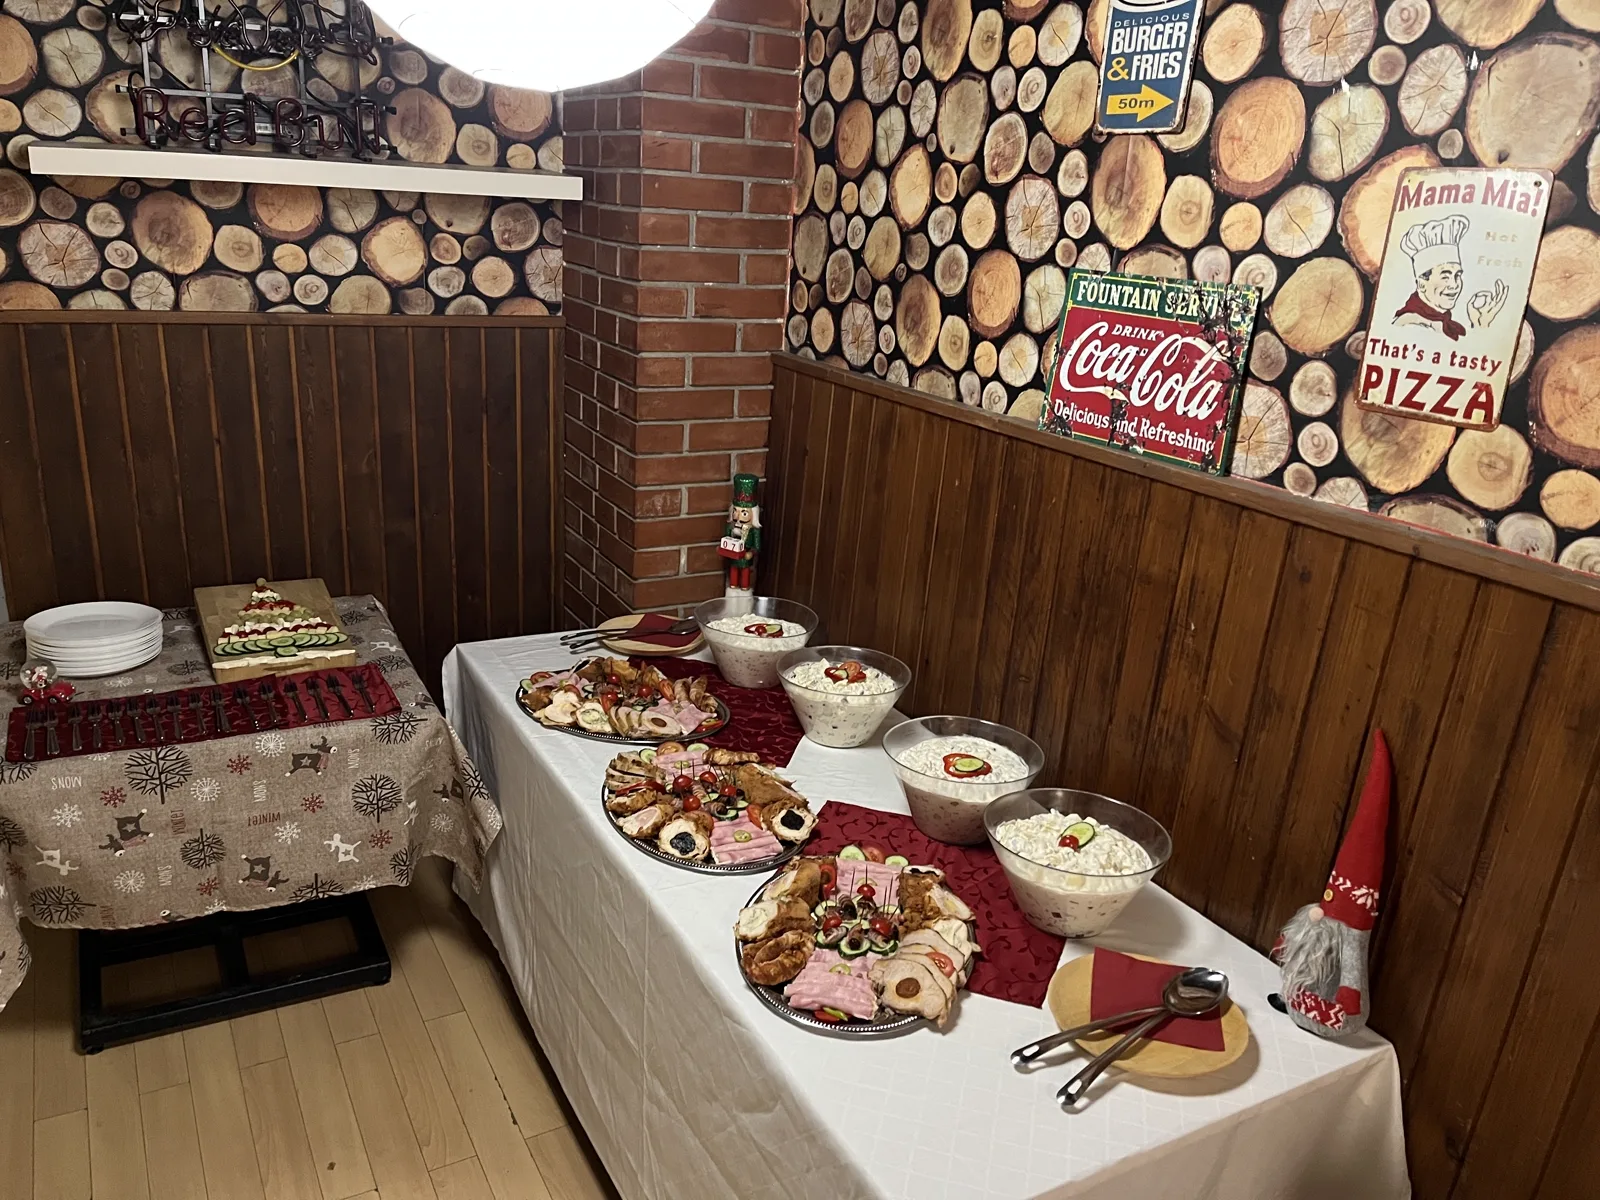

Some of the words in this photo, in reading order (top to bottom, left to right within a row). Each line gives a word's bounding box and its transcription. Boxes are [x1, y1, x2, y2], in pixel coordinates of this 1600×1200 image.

[1114, 12, 1190, 28] DELICIOUS
[1110, 21, 1188, 55] BURGER
[1106, 57, 1129, 81] &
[1130, 51, 1183, 81] FRIES
[1118, 97, 1155, 109] 50m
[1398, 179, 1476, 212] Mama
[1480, 176, 1544, 218] Mia!
[1076, 280, 1162, 312] FOUNTAIN
[1164, 291, 1242, 322] SERVIE
[1111, 323, 1161, 342] DRINK
[1369, 338, 1425, 361] That's
[1431, 349, 1441, 364] a
[1449, 350, 1503, 377] tasty
[1362, 363, 1496, 425] PIZZA
[1053, 398, 1110, 429] Delicious
[1139, 417, 1216, 456] Refreshing
[51, 776, 82, 790] SNOW
